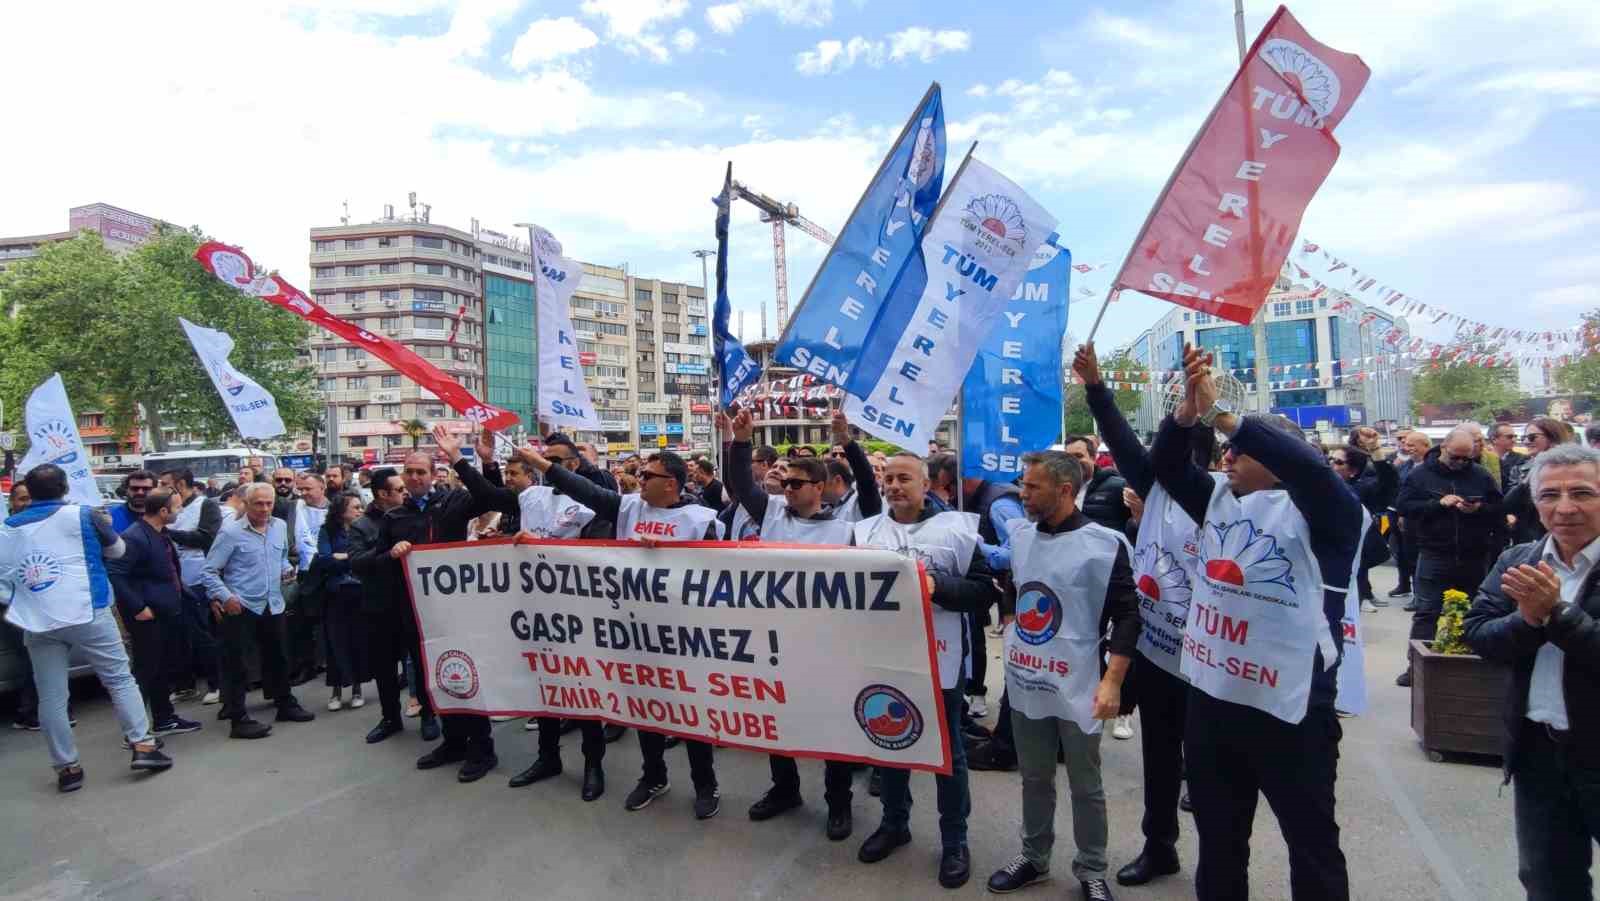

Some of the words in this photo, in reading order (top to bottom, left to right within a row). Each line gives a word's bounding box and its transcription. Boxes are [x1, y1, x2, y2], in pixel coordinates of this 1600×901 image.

[1187, 127, 1289, 277] YEREL
[824, 217, 906, 351] YEREL
[942, 244, 999, 293] TÜM
[790, 346, 849, 387] SEN
[888, 281, 967, 406] YEREL
[1001, 311, 1026, 444] YEREL
[861, 403, 916, 439] SEN
[633, 521, 679, 537] EMEK
[417, 561, 510, 596] TOPLU
[519, 553, 670, 609] SÖZLEŞME
[682, 568, 900, 611] HAKKIMIZ
[510, 610, 583, 644] GASP
[593, 612, 755, 664] EDİLEMEZ
[768, 629, 779, 666] !
[1195, 602, 1249, 646] TÜM
[521, 648, 592, 677] TÜM
[597, 658, 697, 694] YEREL
[707, 672, 787, 704] SEN
[538, 677, 603, 710] İZMİR
[607, 692, 621, 714] 2
[627, 695, 699, 727] NOLU
[706, 707, 779, 744] ŞUBE
